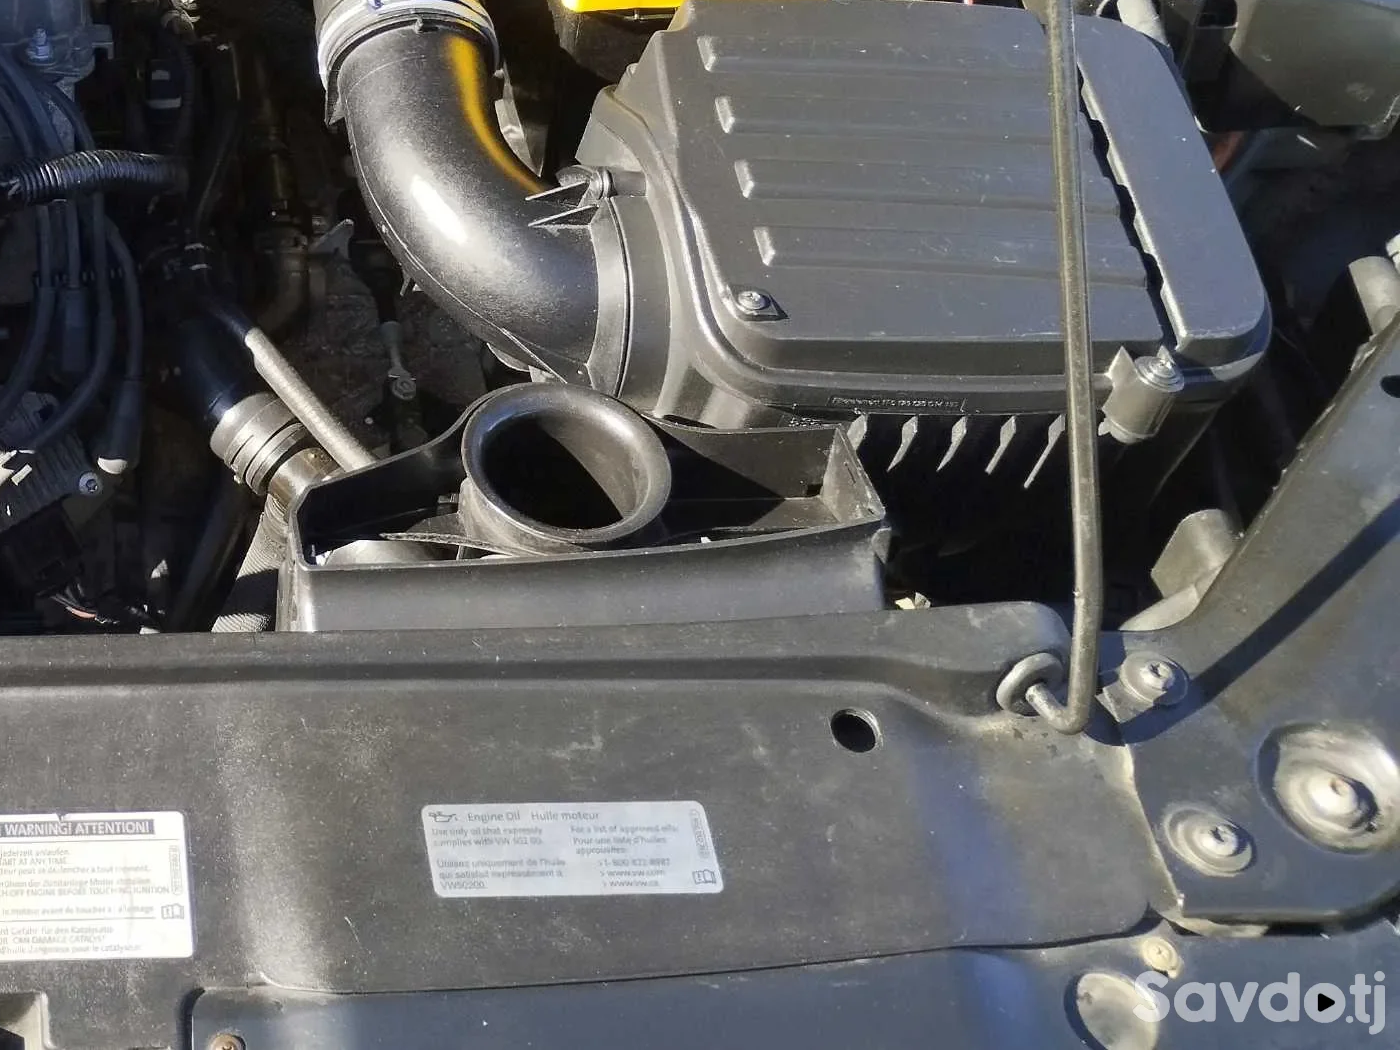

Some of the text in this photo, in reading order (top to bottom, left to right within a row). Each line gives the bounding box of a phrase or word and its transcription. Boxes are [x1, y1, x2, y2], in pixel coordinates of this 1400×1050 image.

[467, 810, 600, 824] Engine Oil Huile moteur
[4, 822, 72, 837] WARNING!
[75, 821, 150, 835] ATTENTION!
